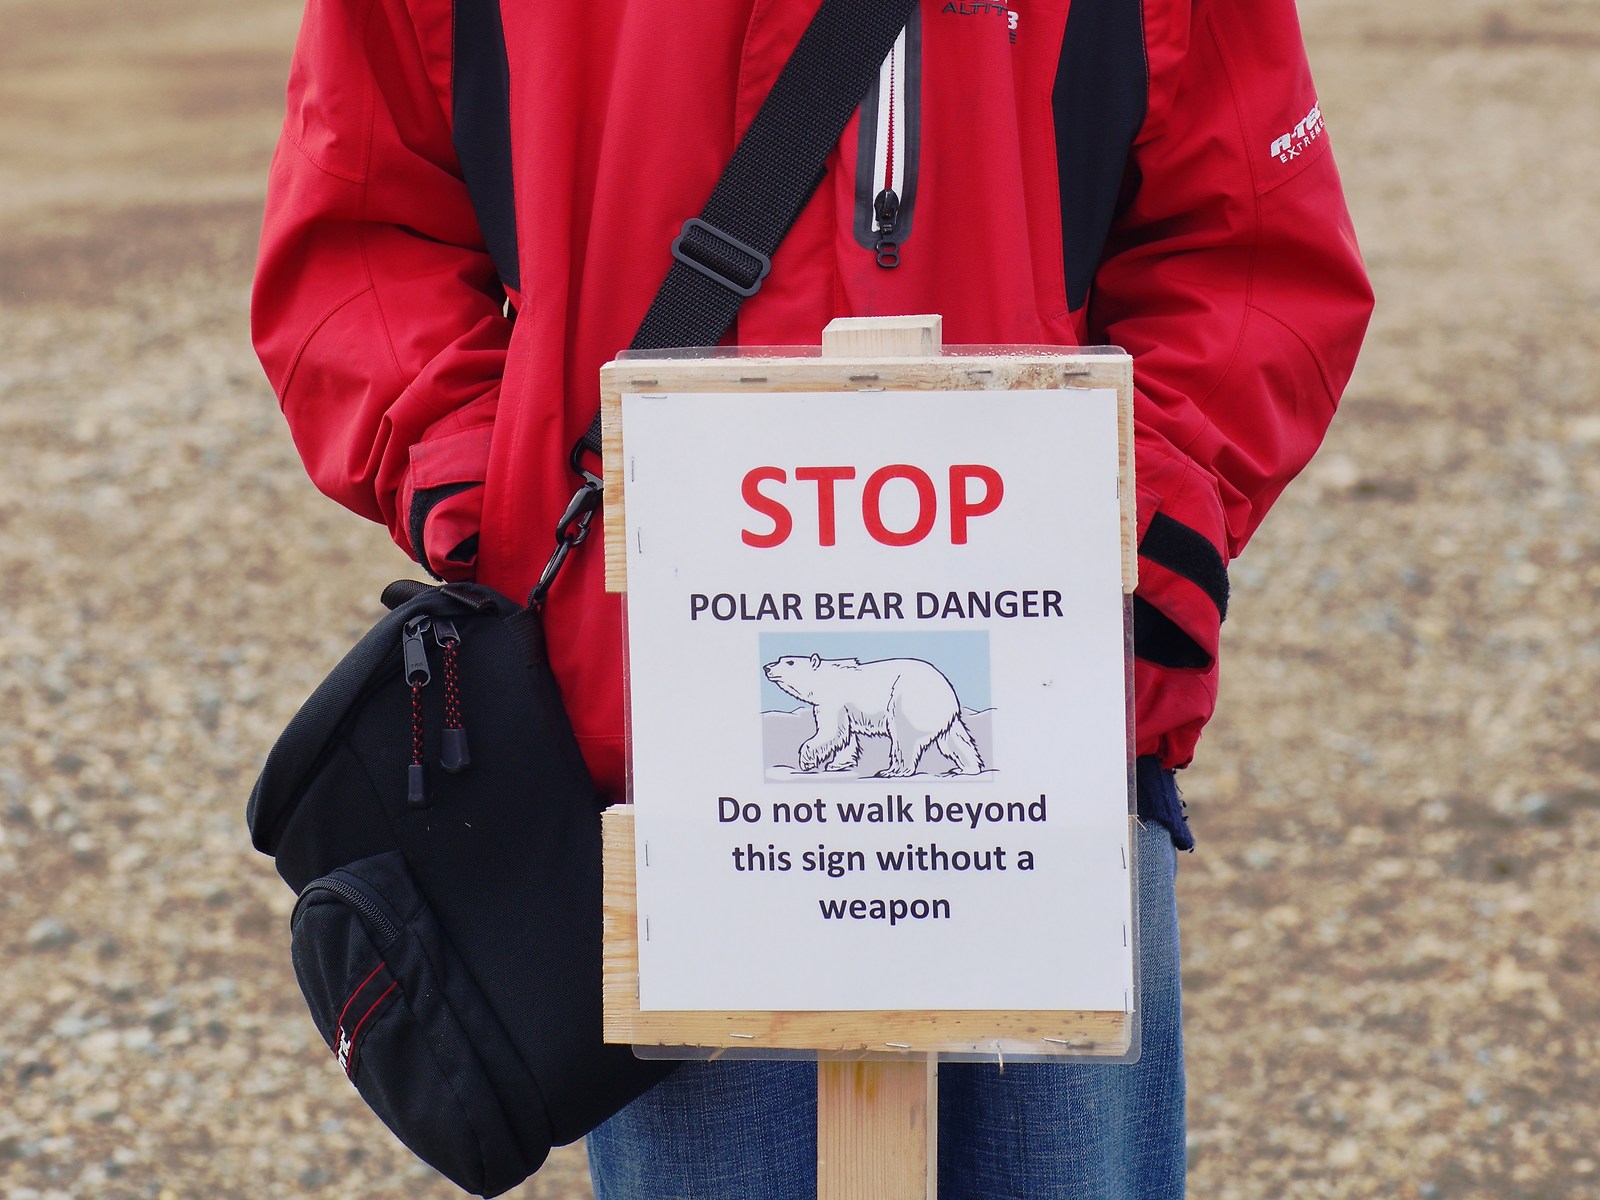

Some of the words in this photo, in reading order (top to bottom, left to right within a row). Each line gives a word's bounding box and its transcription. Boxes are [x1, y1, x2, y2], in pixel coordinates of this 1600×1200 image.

[1279, 117, 1324, 164] EXTREME
[741, 463, 1005, 549] STOP
[690, 593, 803, 621] POLAR
[814, 592, 905, 620] BEAR
[916, 589, 1064, 619] DANGER
[718, 796, 762, 824] Do
[772, 798, 827, 824] not
[836, 794, 915, 823] walk
[924, 793, 1047, 830] beyond
[731, 843, 792, 872] this
[802, 843, 866, 879] sign
[875, 842, 1007, 872] without
[1017, 850, 1035, 871] a
[818, 898, 951, 927] weapon
